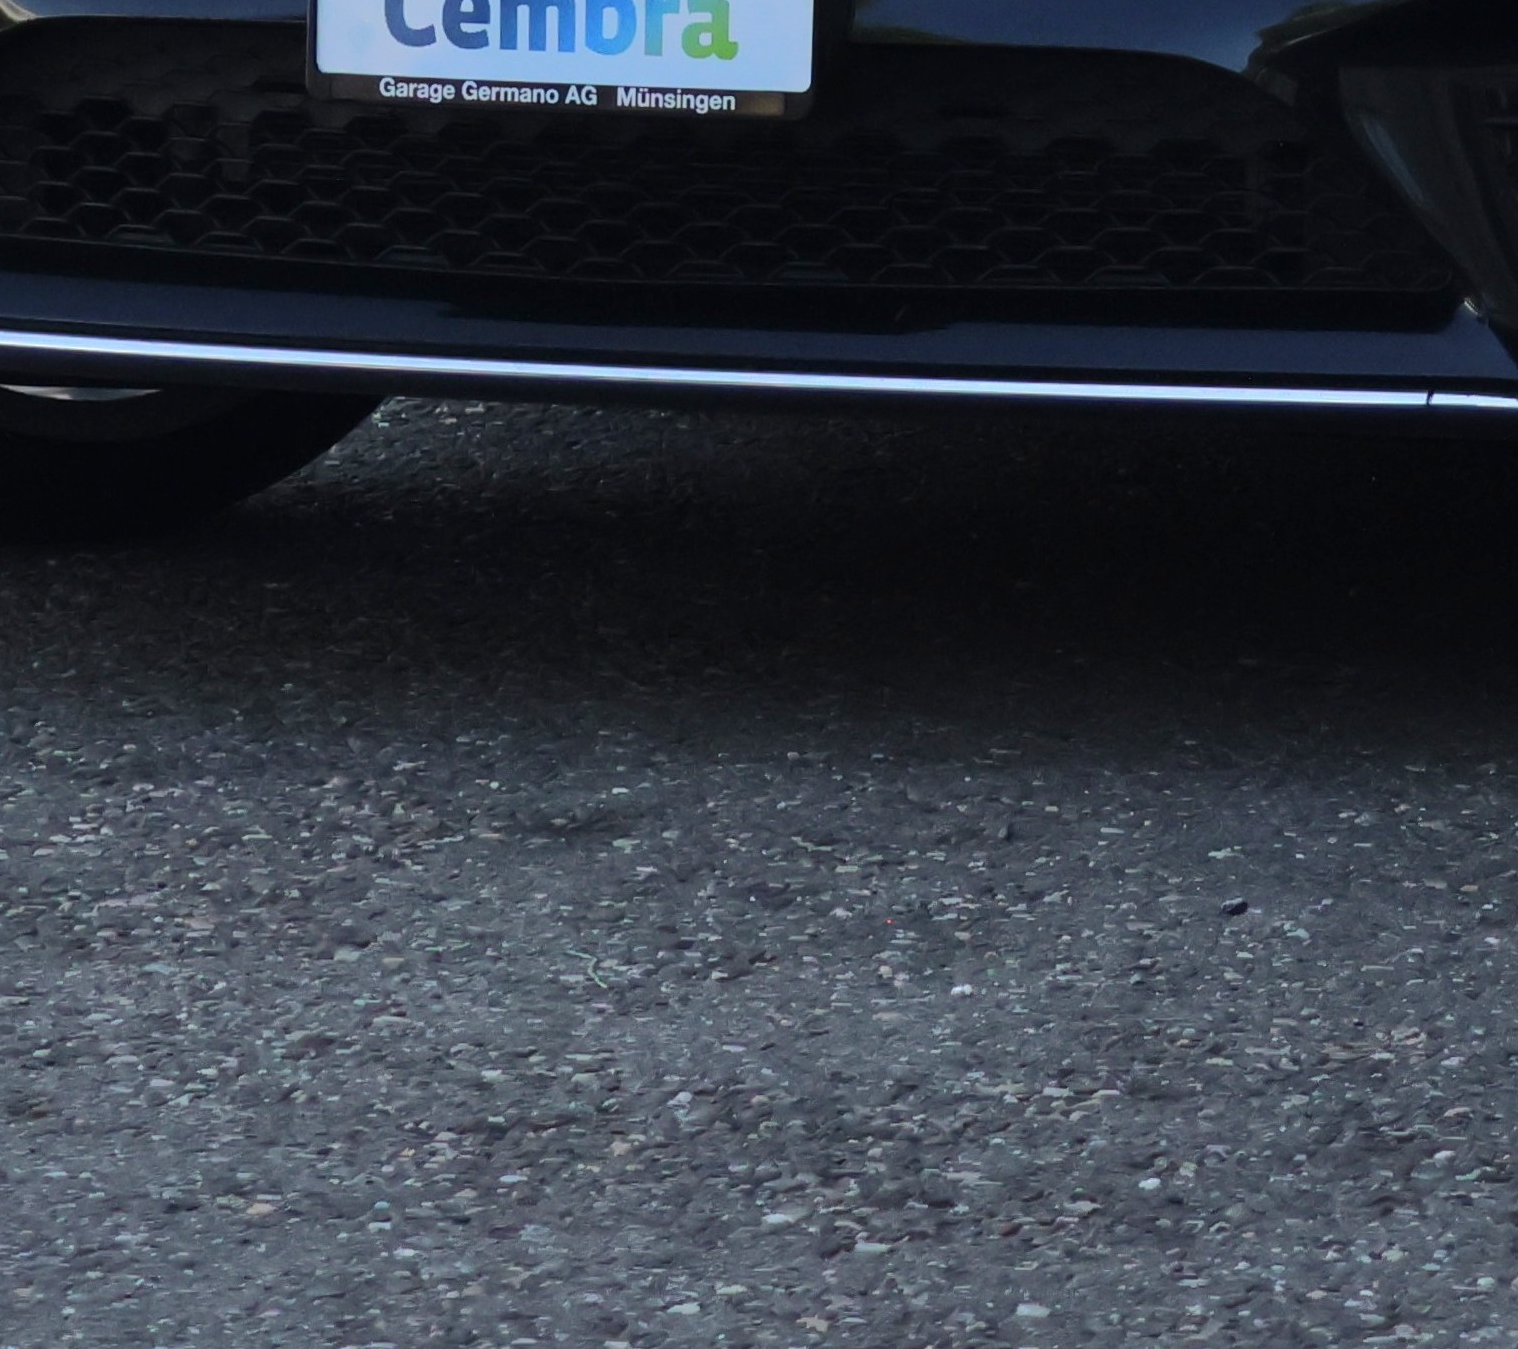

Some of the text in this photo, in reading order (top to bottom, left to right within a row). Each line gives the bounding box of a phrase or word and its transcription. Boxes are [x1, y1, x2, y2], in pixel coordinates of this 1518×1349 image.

[379, 77, 737, 114] Garage Germano AG Münsingen
